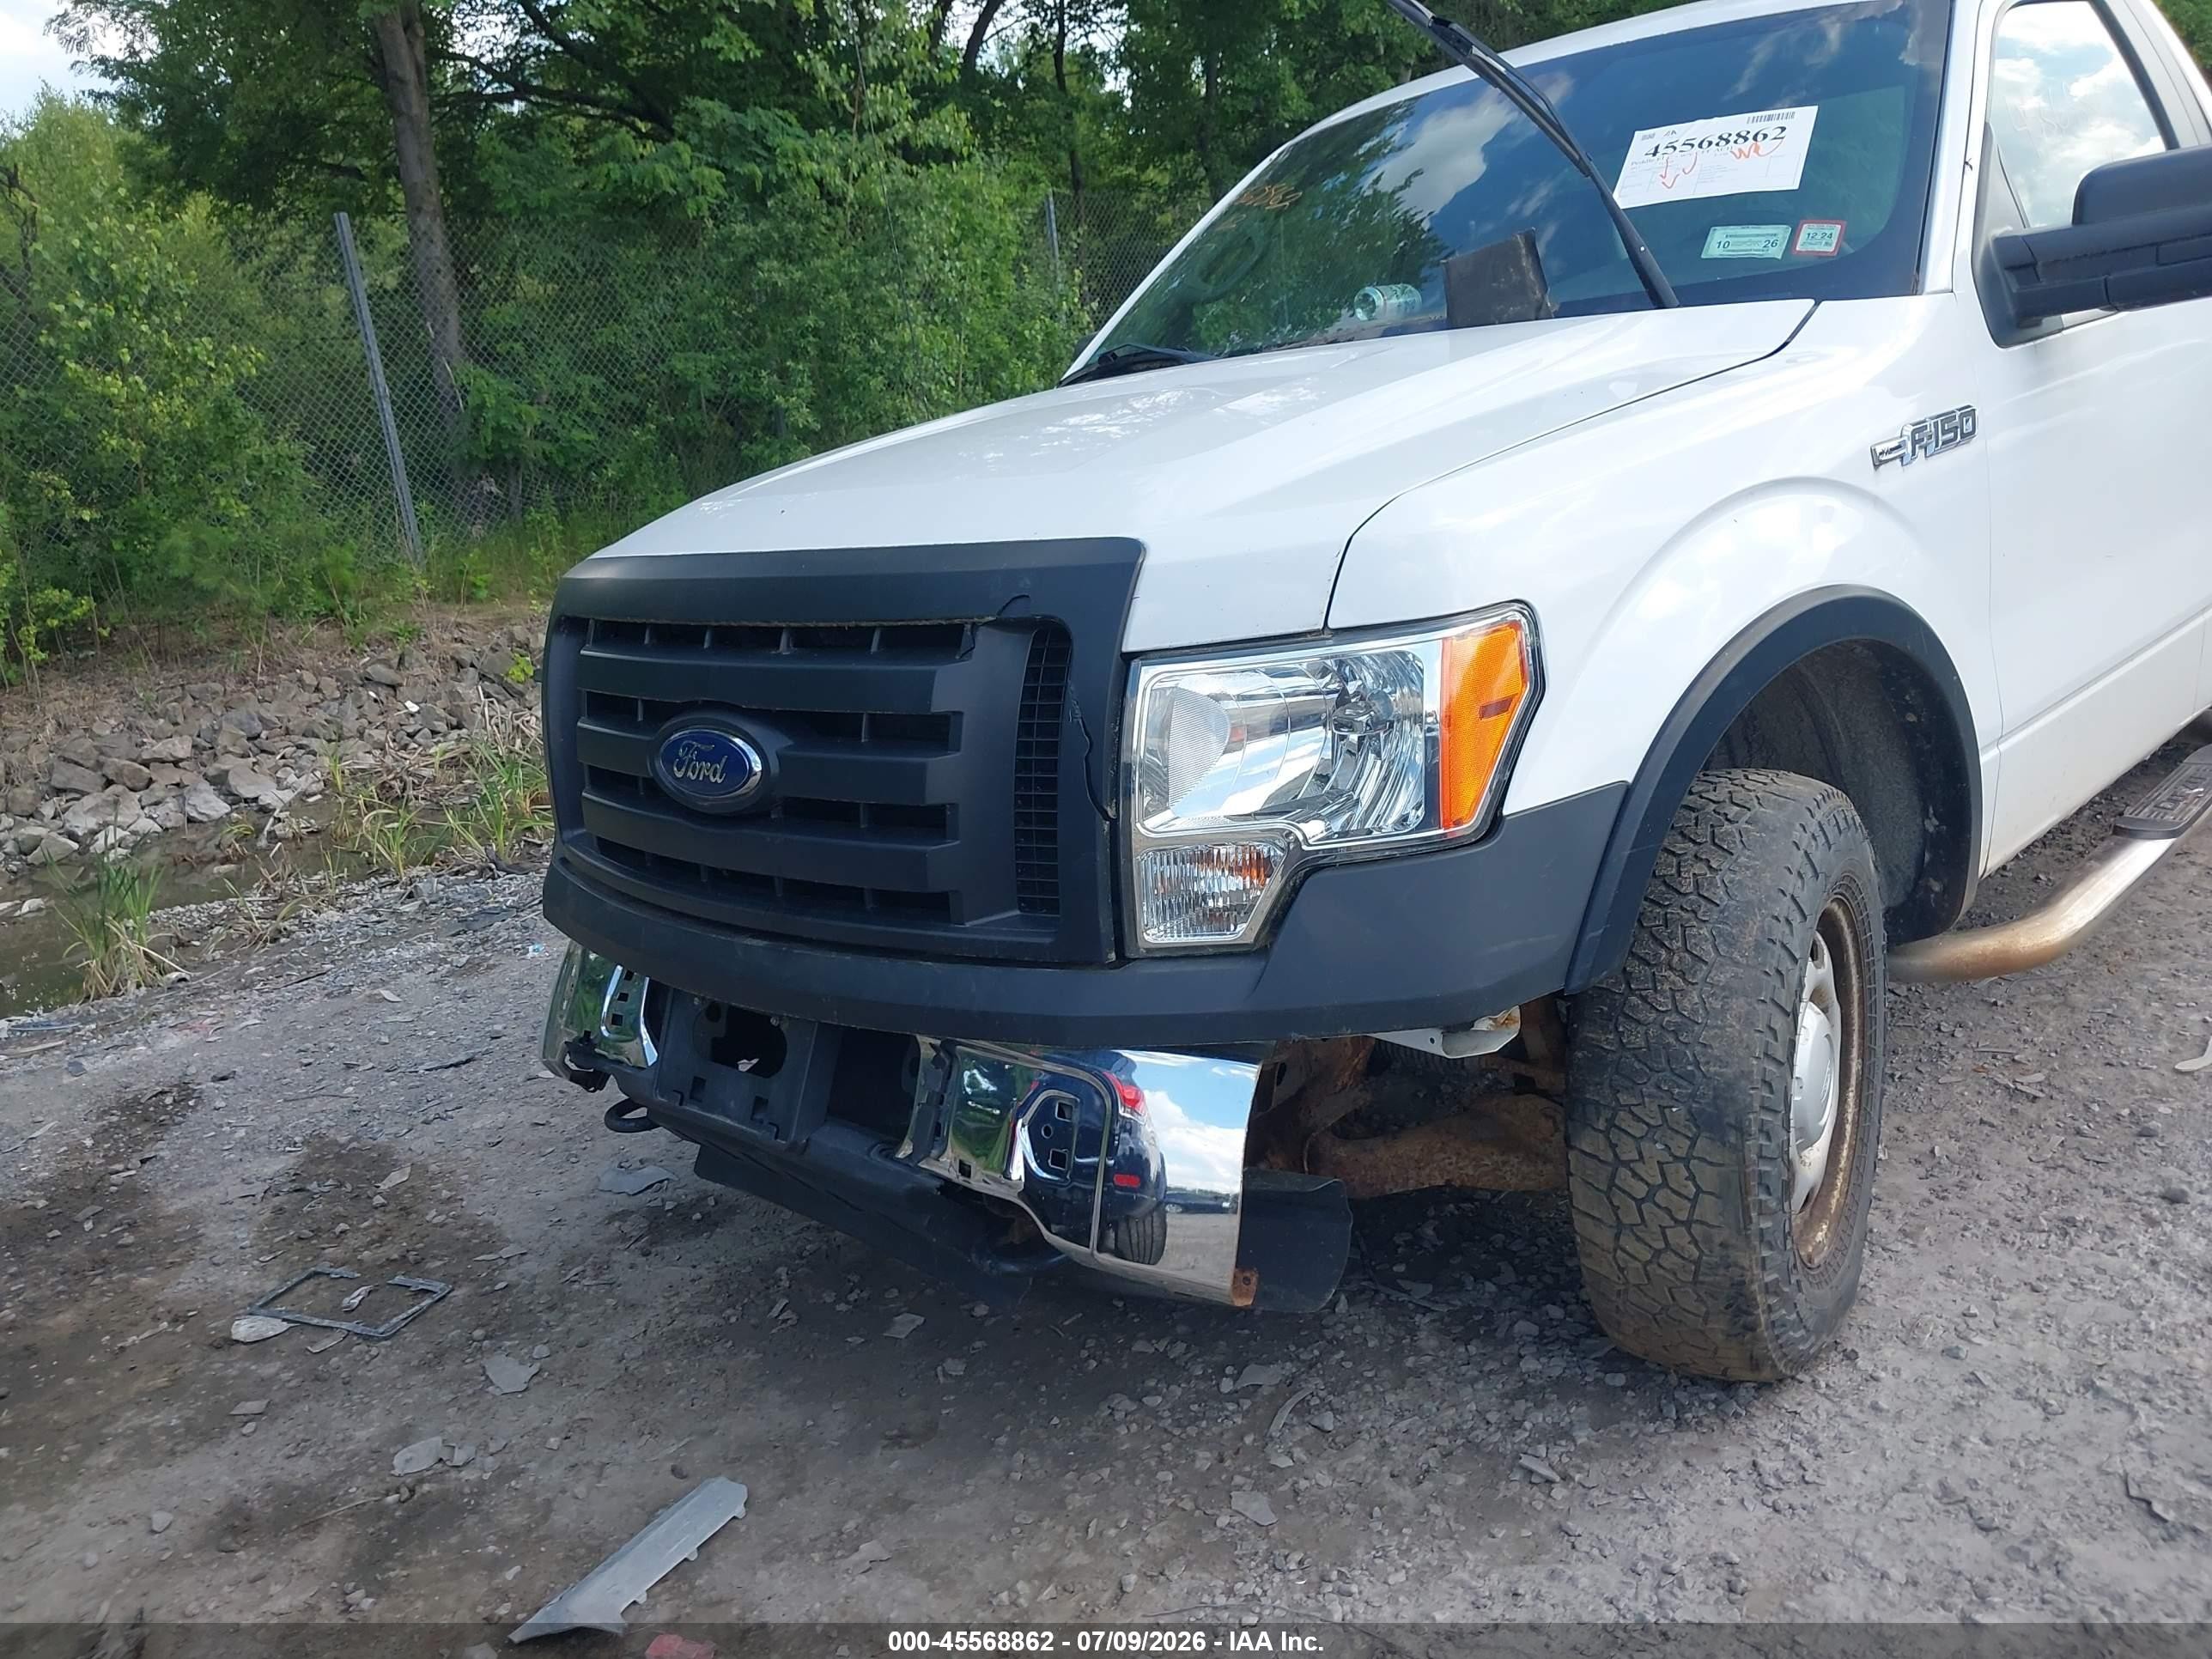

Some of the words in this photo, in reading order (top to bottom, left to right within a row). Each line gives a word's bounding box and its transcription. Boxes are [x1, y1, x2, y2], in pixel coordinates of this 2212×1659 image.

[1644, 126, 1787, 157] 45568862
[1717, 240, 1730, 249] 10
[1763, 240, 1778, 248] 26
[673, 740, 728, 784] Ford
